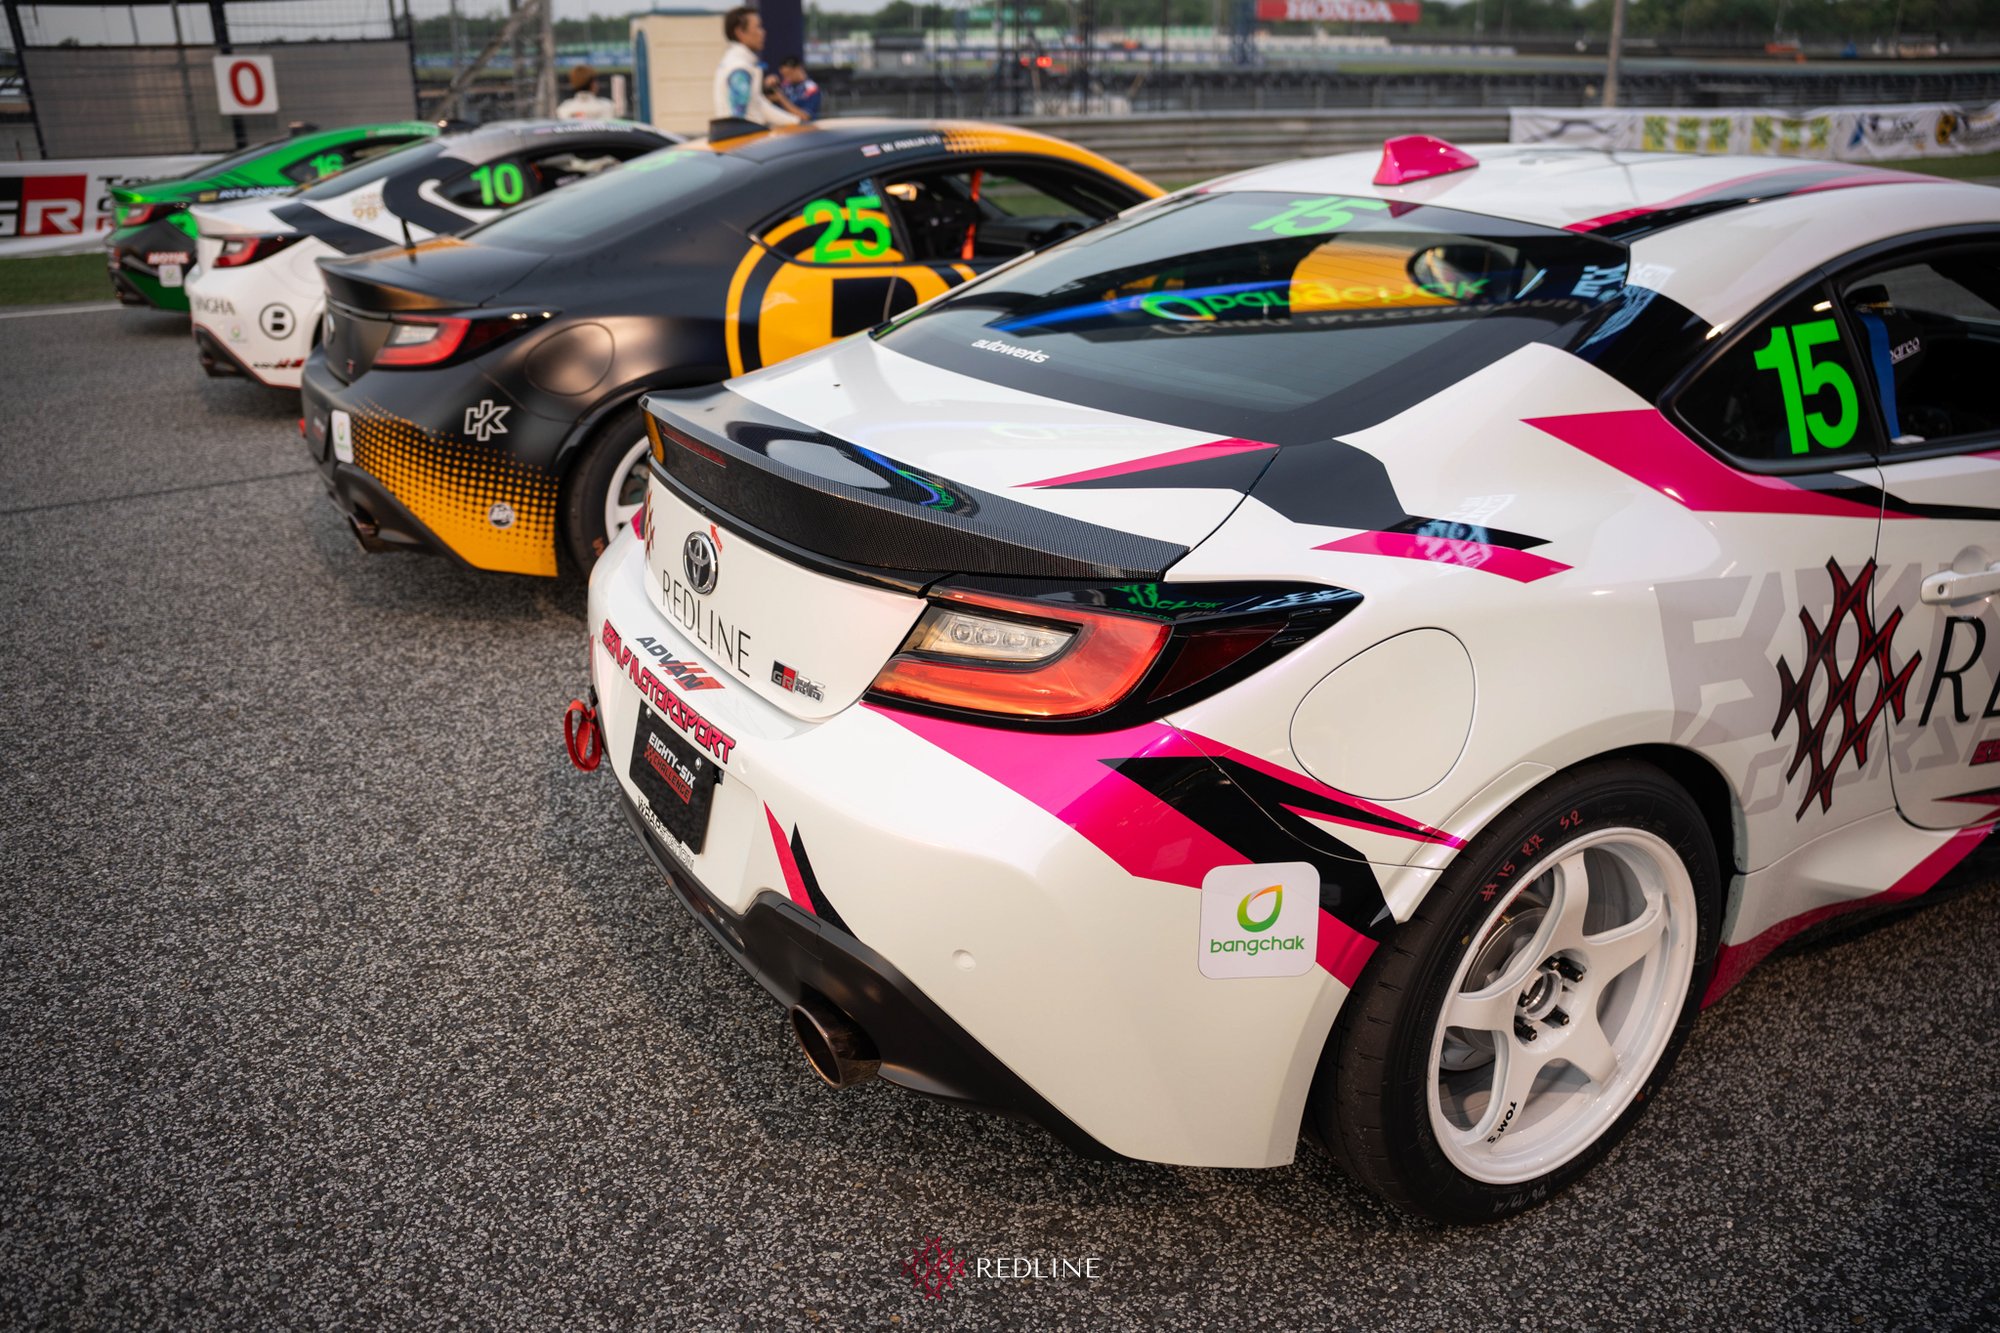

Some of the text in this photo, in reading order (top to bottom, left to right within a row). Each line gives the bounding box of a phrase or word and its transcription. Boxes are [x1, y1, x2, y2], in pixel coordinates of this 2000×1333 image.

[1286, 0, 1394, 22] HONDA
[228, 60, 265, 108] 0
[470, 163, 524, 206] 10
[803, 195, 892, 263] 25
[1248, 196, 1391, 236] 15
[971, 339, 1050, 363] autowerks
[1753, 318, 1859, 455] 15
[662, 569, 751, 678] REDLINE
[635, 636, 710, 690] ADVAN
[628, 653, 738, 765] MOTORSPORT
[648, 731, 697, 790] EIGHTY-SIX
[650, 751, 692, 802] CHALLENGE
[1210, 935, 1305, 957] bangchak
